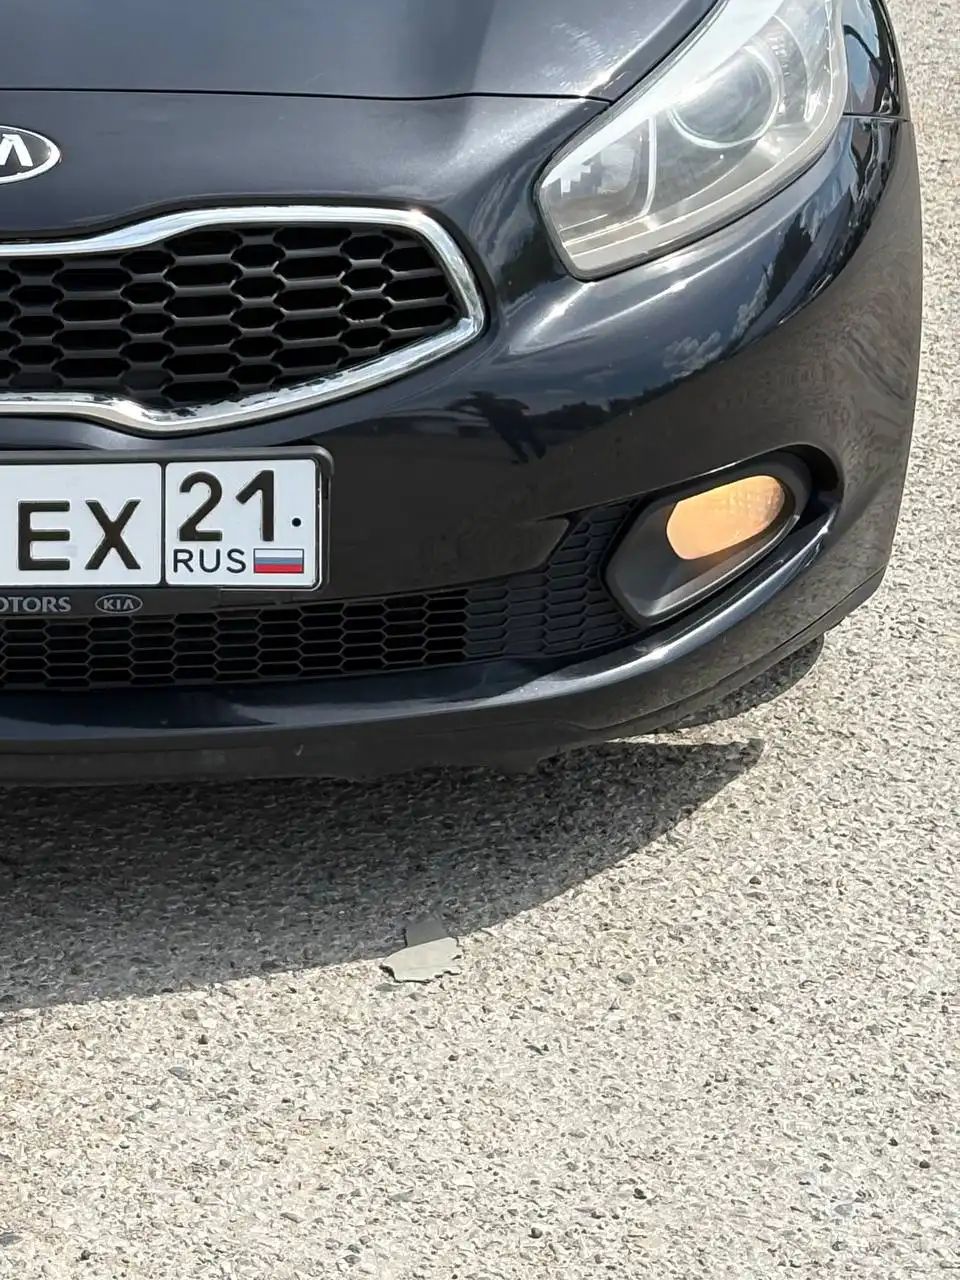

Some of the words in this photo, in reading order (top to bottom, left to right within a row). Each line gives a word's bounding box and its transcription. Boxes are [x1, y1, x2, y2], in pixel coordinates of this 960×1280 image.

[178, 469, 275, 542] 21
[172, 548, 247, 574] RUS
[103, 599, 135, 610] KIA
